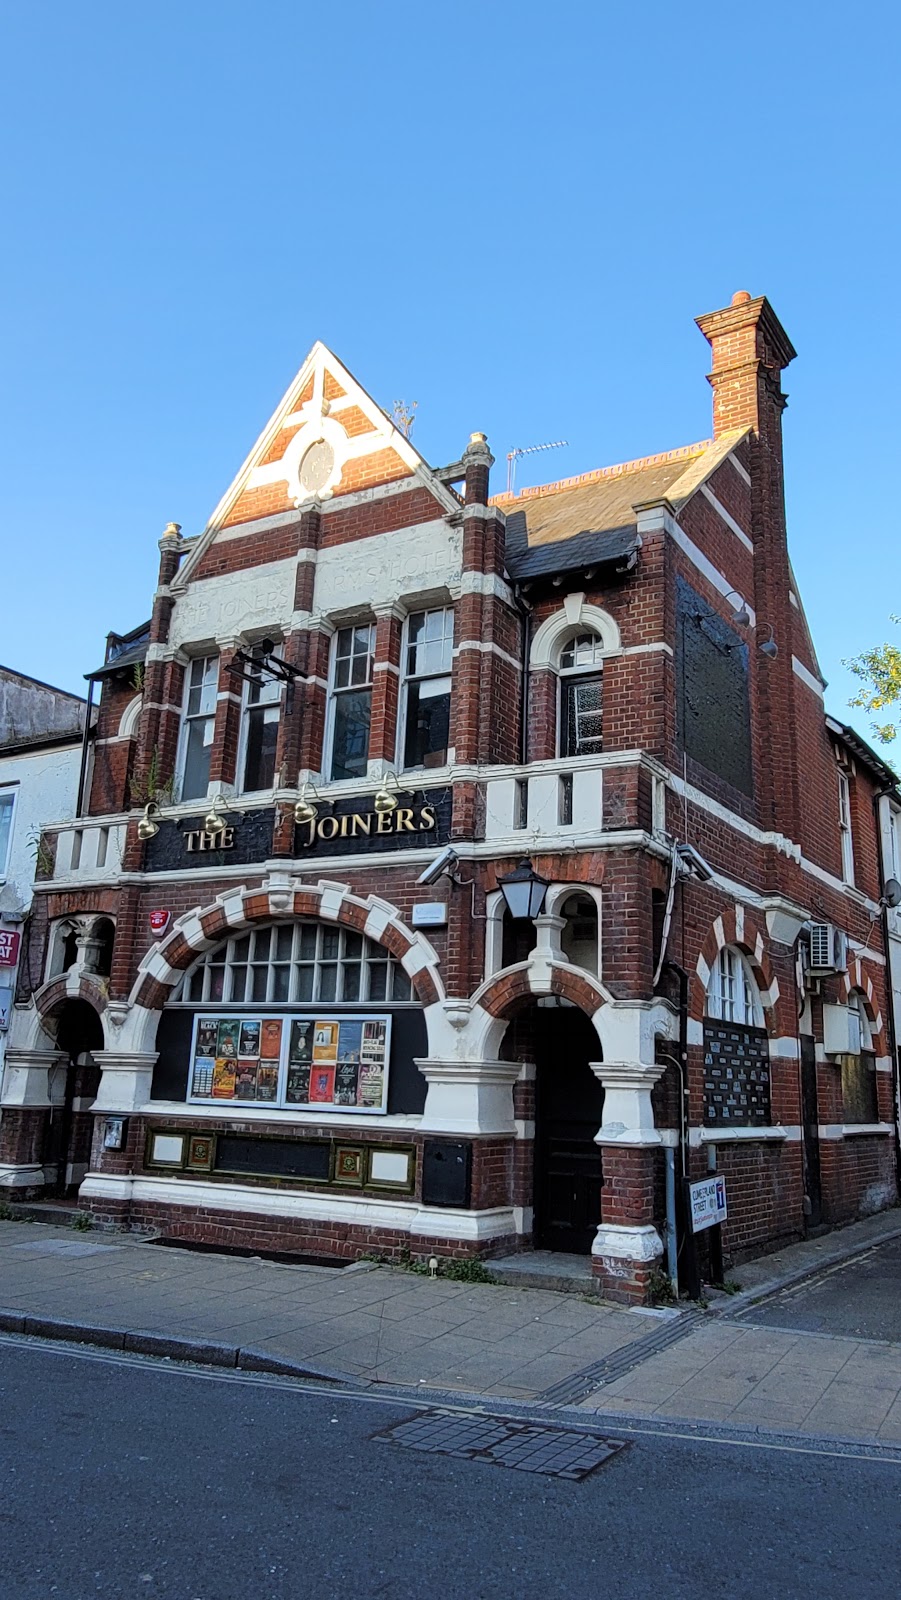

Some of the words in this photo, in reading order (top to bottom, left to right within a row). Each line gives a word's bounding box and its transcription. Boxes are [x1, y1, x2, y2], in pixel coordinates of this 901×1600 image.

[217, 589, 289, 623] JOINERS
[319, 566, 377, 594] ARMS
[388, 548, 460, 579] HOTEL
[182, 827, 234, 852] THE
[303, 806, 435, 848] JOINERS
[694, 1200, 706, 1214] STREET
